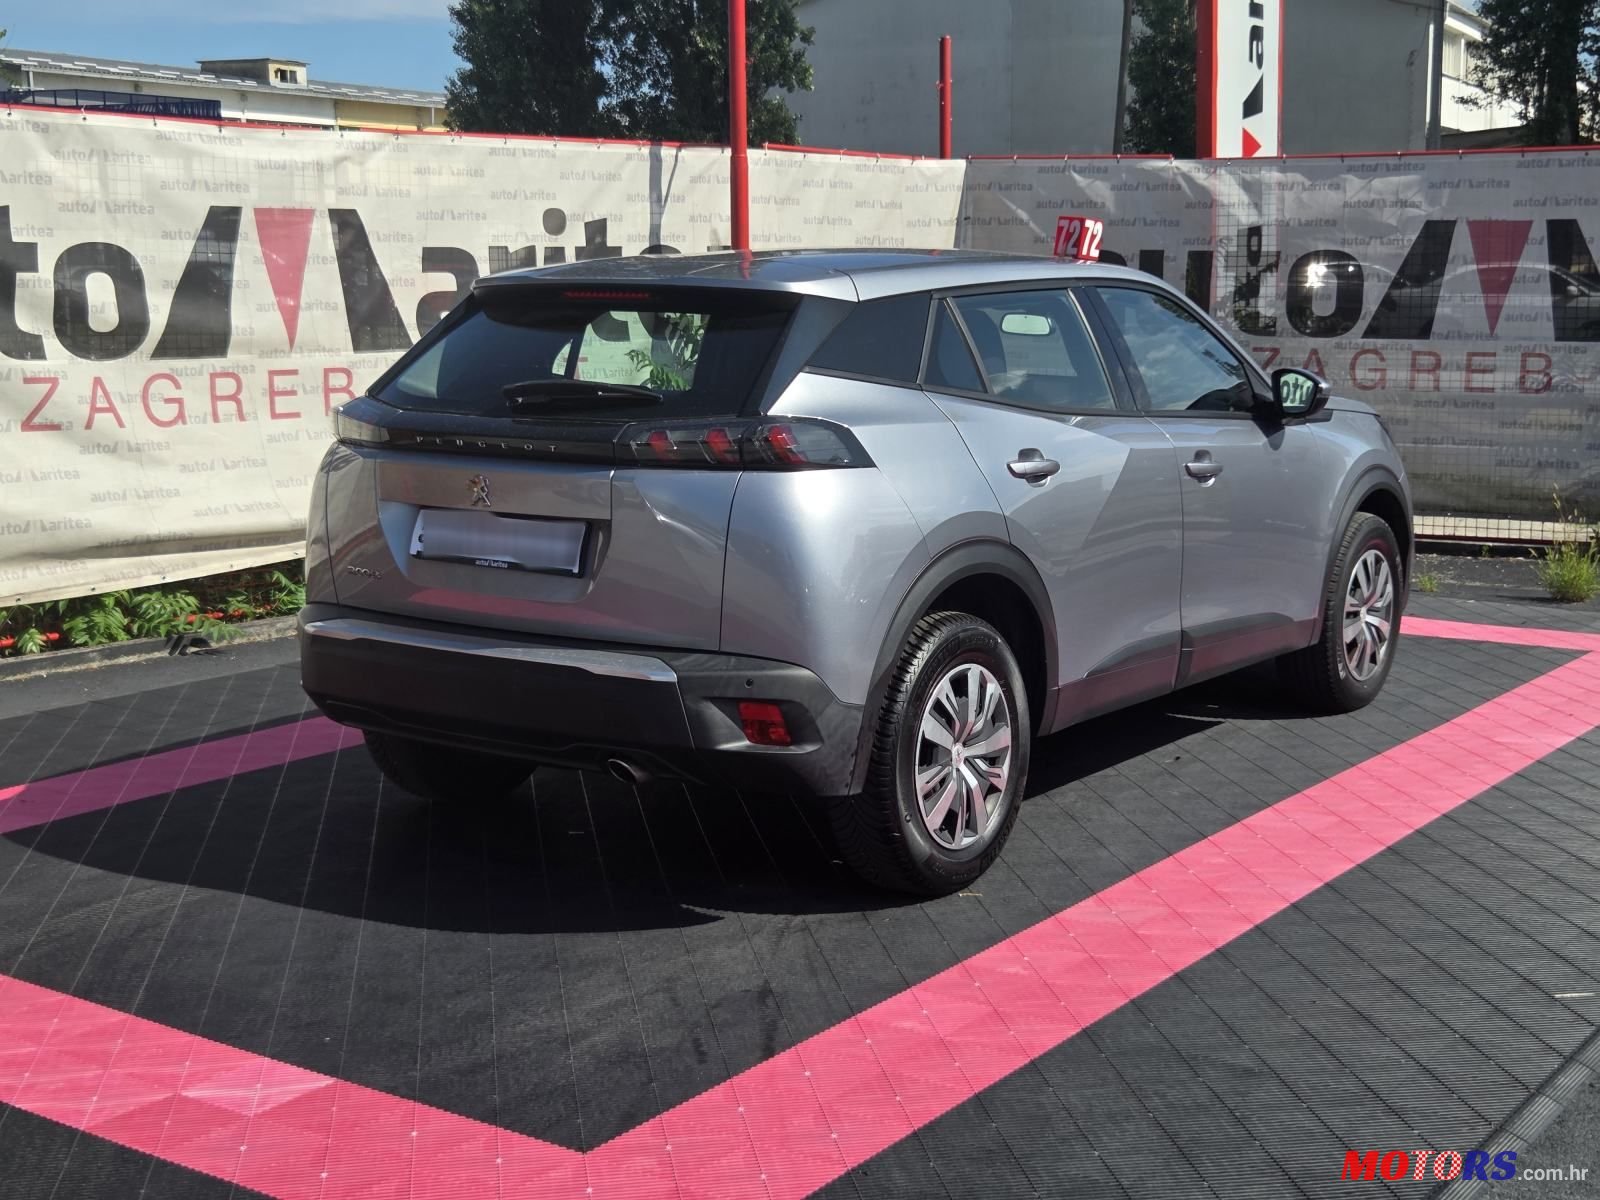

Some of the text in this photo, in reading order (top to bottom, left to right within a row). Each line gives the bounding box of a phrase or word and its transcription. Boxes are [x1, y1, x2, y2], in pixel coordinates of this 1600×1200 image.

[1056, 219, 1080, 257] 72
[1082, 219, 1103, 257] 72
[1251, 347, 1553, 394] ZAGREB
[416, 436, 557, 453] PEUGEOT
